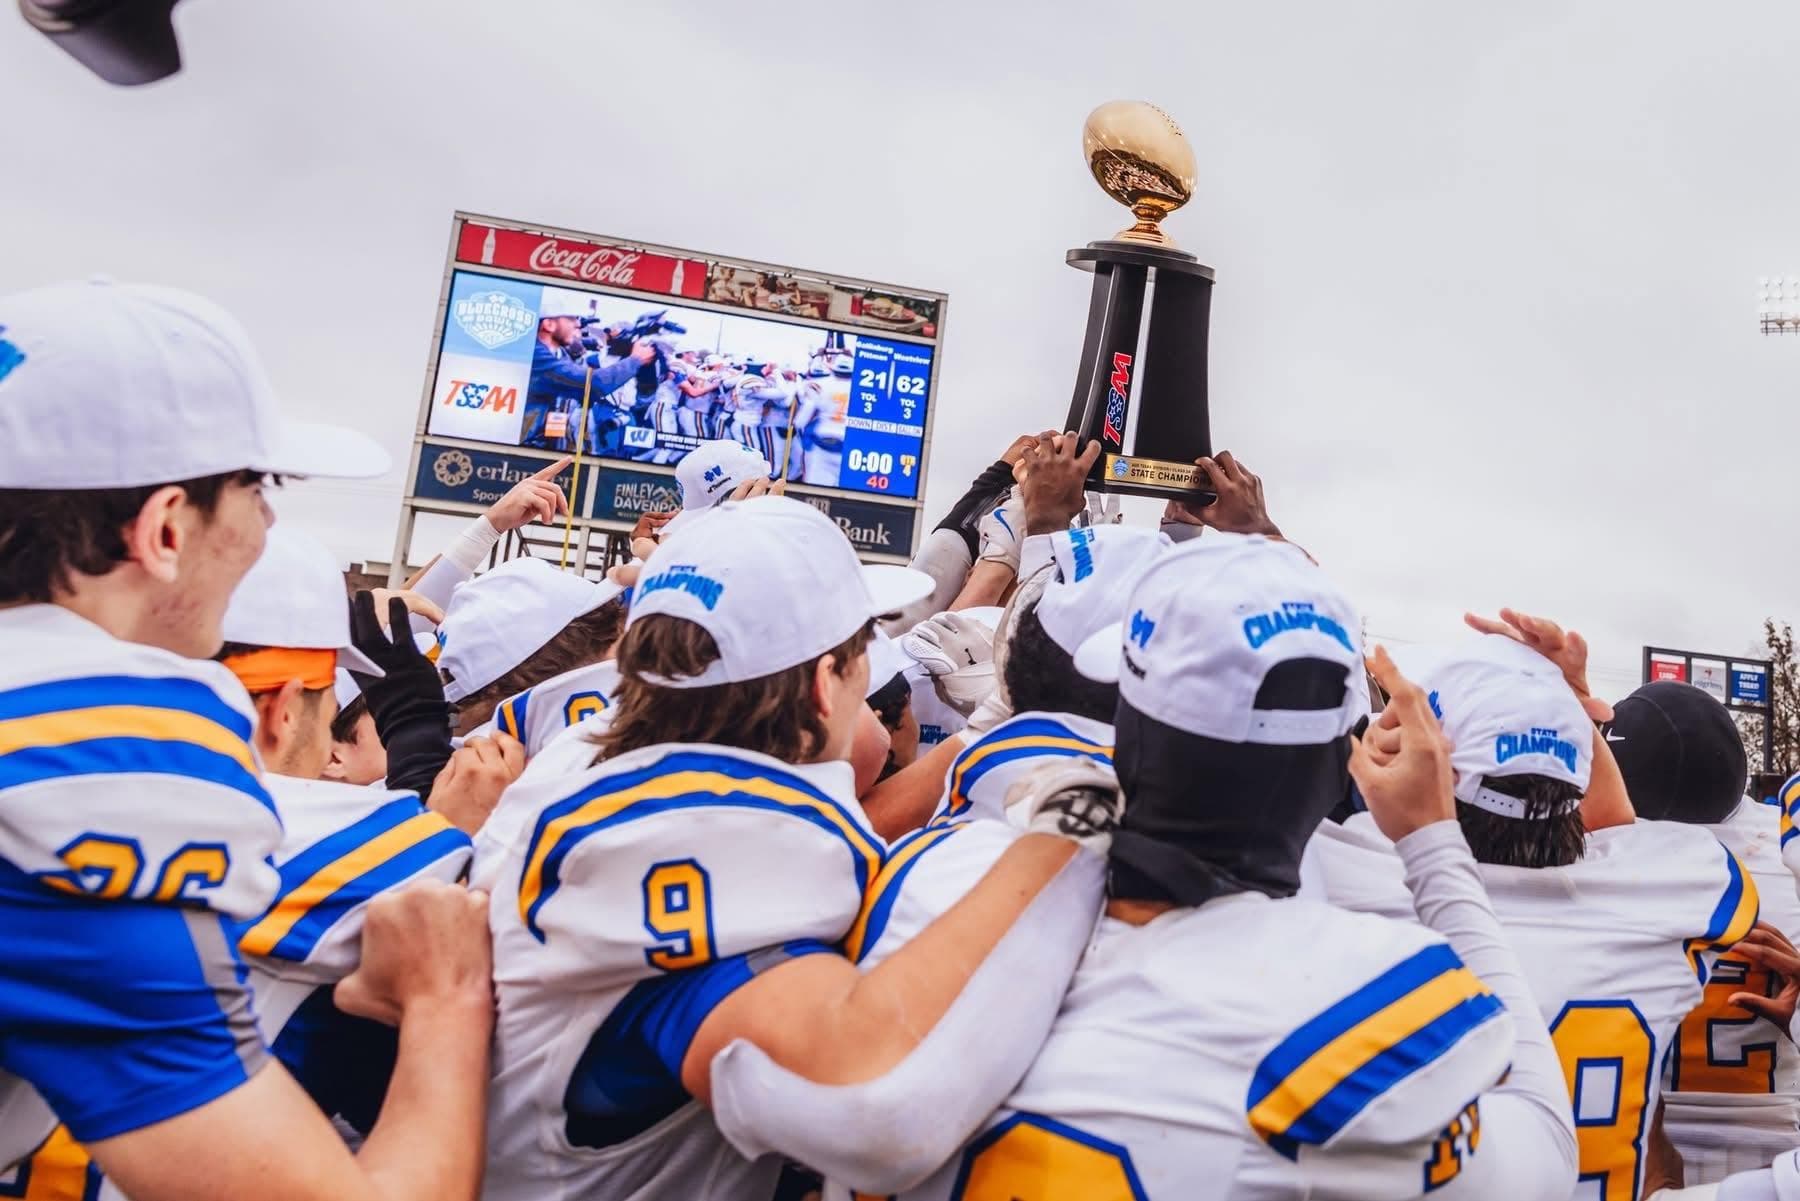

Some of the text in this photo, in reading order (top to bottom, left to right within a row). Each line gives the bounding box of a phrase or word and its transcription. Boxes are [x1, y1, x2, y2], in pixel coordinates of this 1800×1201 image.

[859, 369, 887, 390] 21
[897, 375, 925, 395] 62
[861, 392, 877, 402] TOL
[864, 402, 872, 413] 3
[900, 398, 916, 408] TOL
[903, 408, 911, 419] 3
[848, 418, 871, 429] DOWN
[848, 448, 893, 475] 0:00
[1130, 468, 1155, 479] STATE
[866, 475, 889, 489] 40
[615, 483, 655, 499] FINLEY
[1531, 727, 1558, 738] STATE
[643, 858, 718, 973] 9
